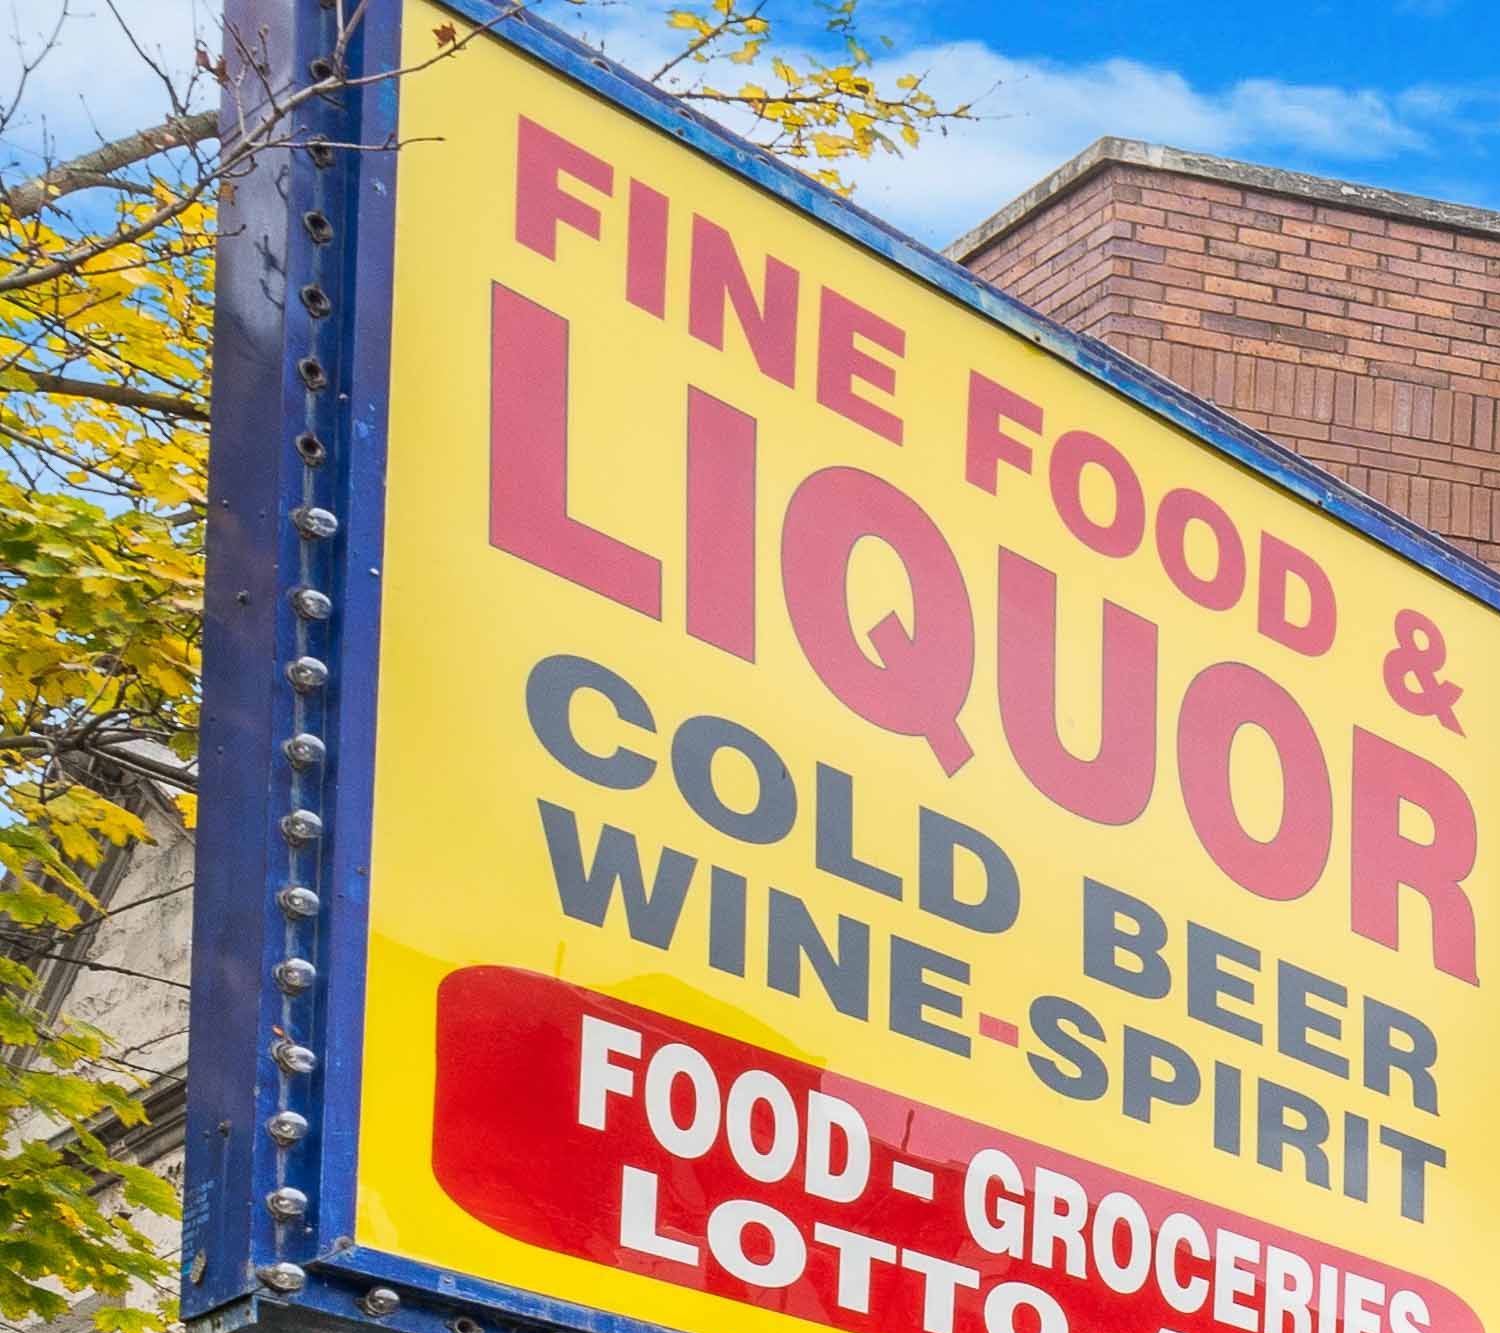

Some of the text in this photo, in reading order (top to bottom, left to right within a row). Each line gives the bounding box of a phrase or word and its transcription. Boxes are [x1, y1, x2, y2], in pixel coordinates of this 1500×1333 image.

[490, 280, 1480, 986] LIQUOR
[516, 116, 1465, 736] FINE FOOD &
[525, 654, 1441, 1118] COLD BEER
[538, 799, 1446, 1223] WINE-SPIRIT
[578, 1013, 873, 1205] FOOD
